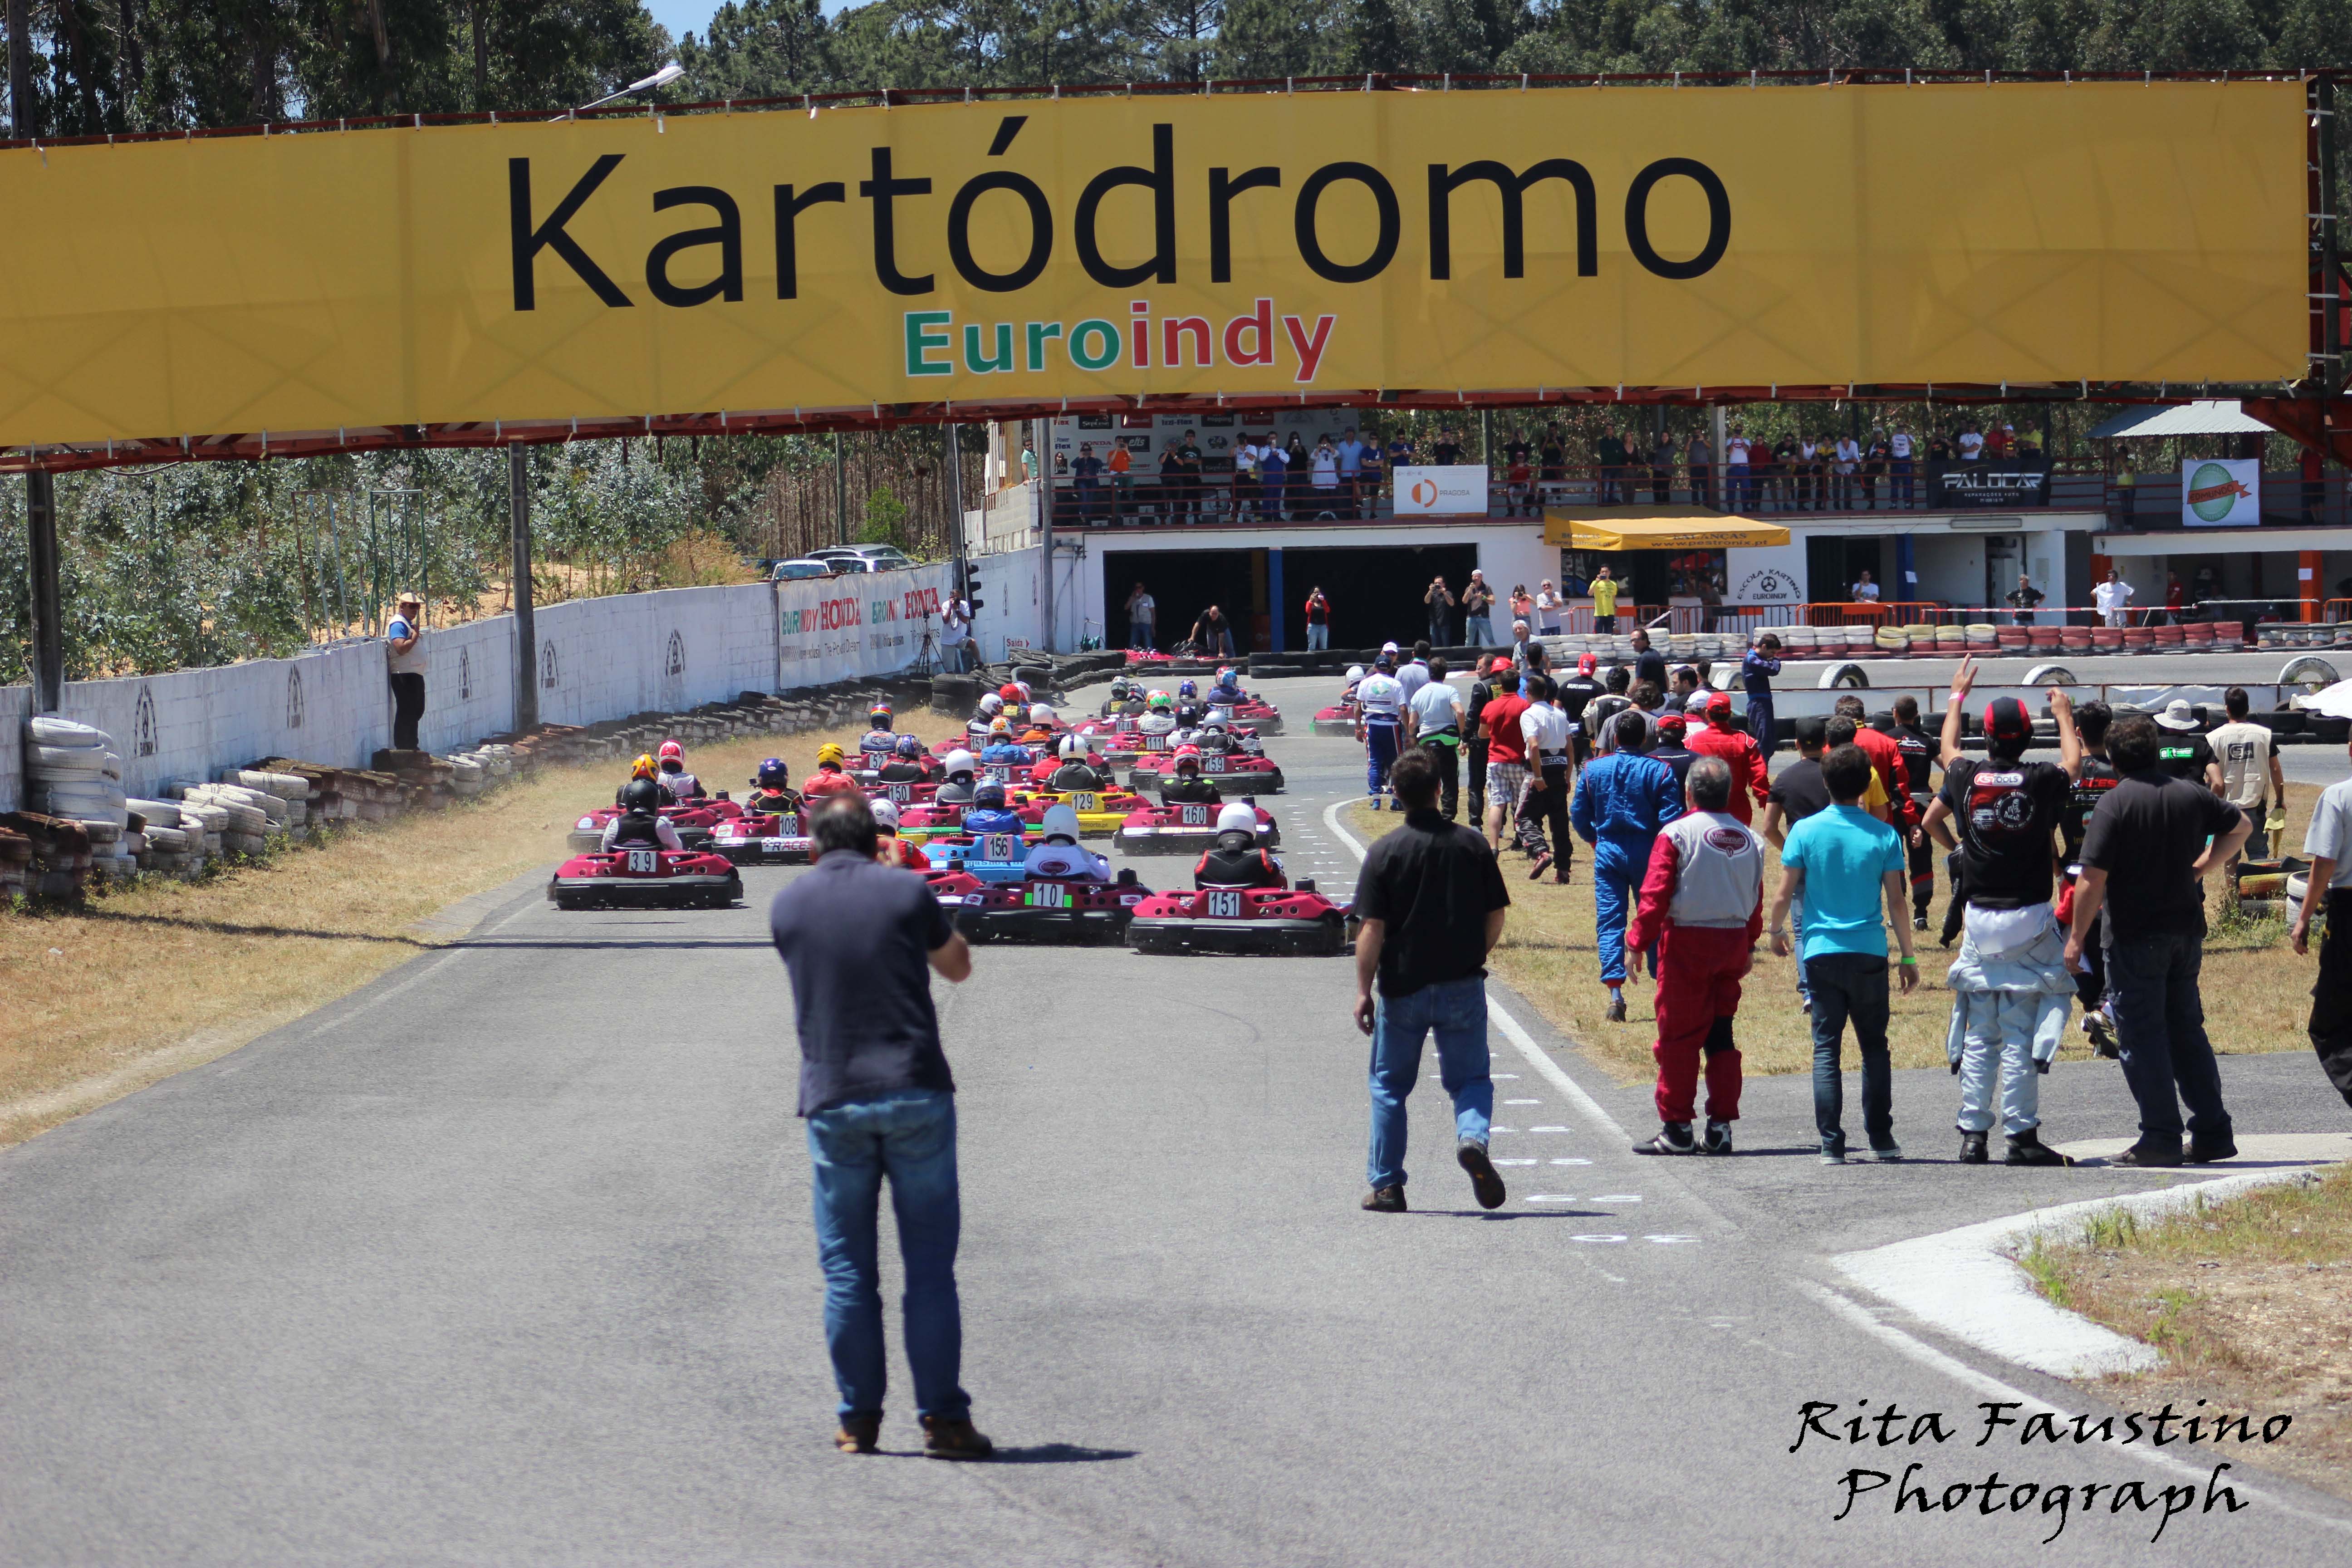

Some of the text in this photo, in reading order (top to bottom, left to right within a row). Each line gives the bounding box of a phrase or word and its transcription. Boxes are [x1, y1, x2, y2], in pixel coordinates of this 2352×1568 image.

[510, 117, 1730, 310] Kartódromo
[904, 298, 1337, 383] Euroindy
[1942, 473, 2044, 489] PALOCAR
[2190, 485, 2234, 501] EDMUNDO
[1737, 568, 1801, 600] ESCOLA KARTING
[1117, 721, 1132, 731] 144
[972, 738, 985, 750] 157
[1148, 737, 1162, 750] 111
[873, 756, 884, 769] 52
[1206, 758, 1223, 771] 159
[890, 786, 906, 801] 150
[1073, 794, 1093, 810] 129
[1185, 806, 1205, 824] 160
[780, 817, 796, 835] 108
[1710, 834, 1744, 843] Millennium
[990, 837, 1008, 857] 156
[1039, 884, 1058, 906] 10
[1211, 892, 1239, 916] 151
